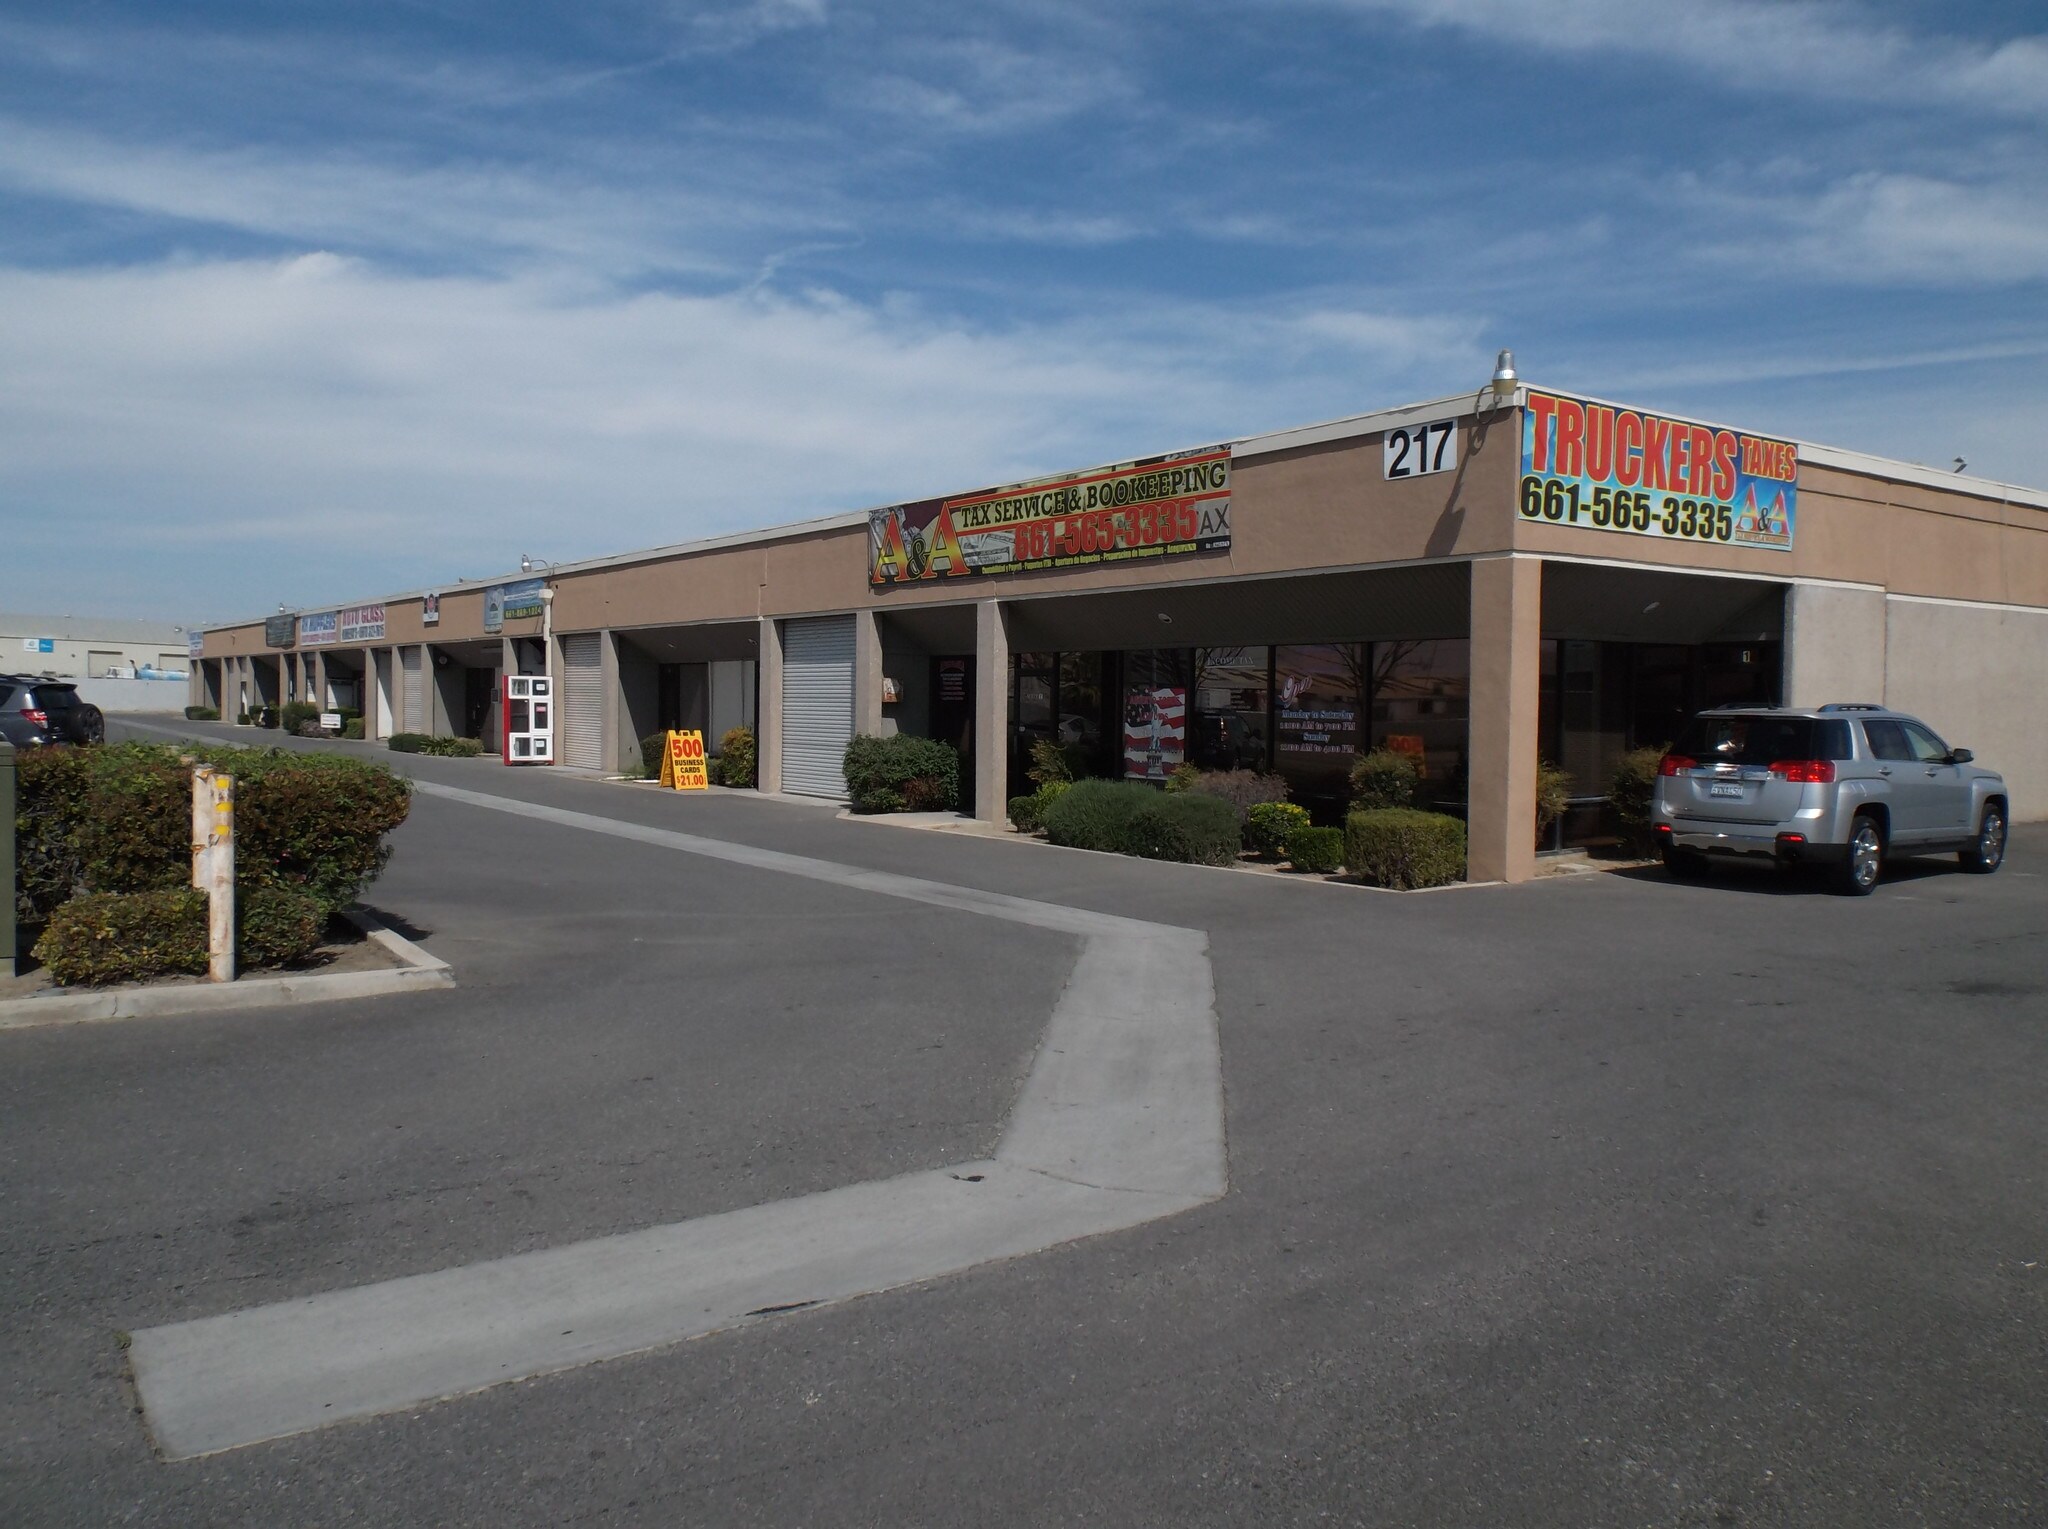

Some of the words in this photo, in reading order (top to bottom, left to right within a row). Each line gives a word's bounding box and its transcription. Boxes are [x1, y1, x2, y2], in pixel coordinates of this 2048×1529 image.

[1388, 421, 1454, 478] 217
[1528, 392, 1737, 501] TRUCKERS
[1740, 435, 1797, 483] TAXES
[961, 506, 992, 528] TAX
[995, 491, 1064, 523] SERVICE
[1068, 488, 1082, 512] &
[1086, 461, 1226, 508] BOOKEEPING
[1520, 475, 1733, 541] 661-565-3335
[1735, 481, 1790, 535] A&A
[872, 501, 971, 584] A&A
[1015, 500, 1198, 561] 661-565-3335
[361, 605, 384, 623] GLASS
[1281, 710, 1311, 720] Monday
[1320, 710, 1354, 720] Saturday
[1303, 732, 1331, 743] Sunday
[672, 738, 703, 759] 500
[676, 775, 704, 786] $21.00
